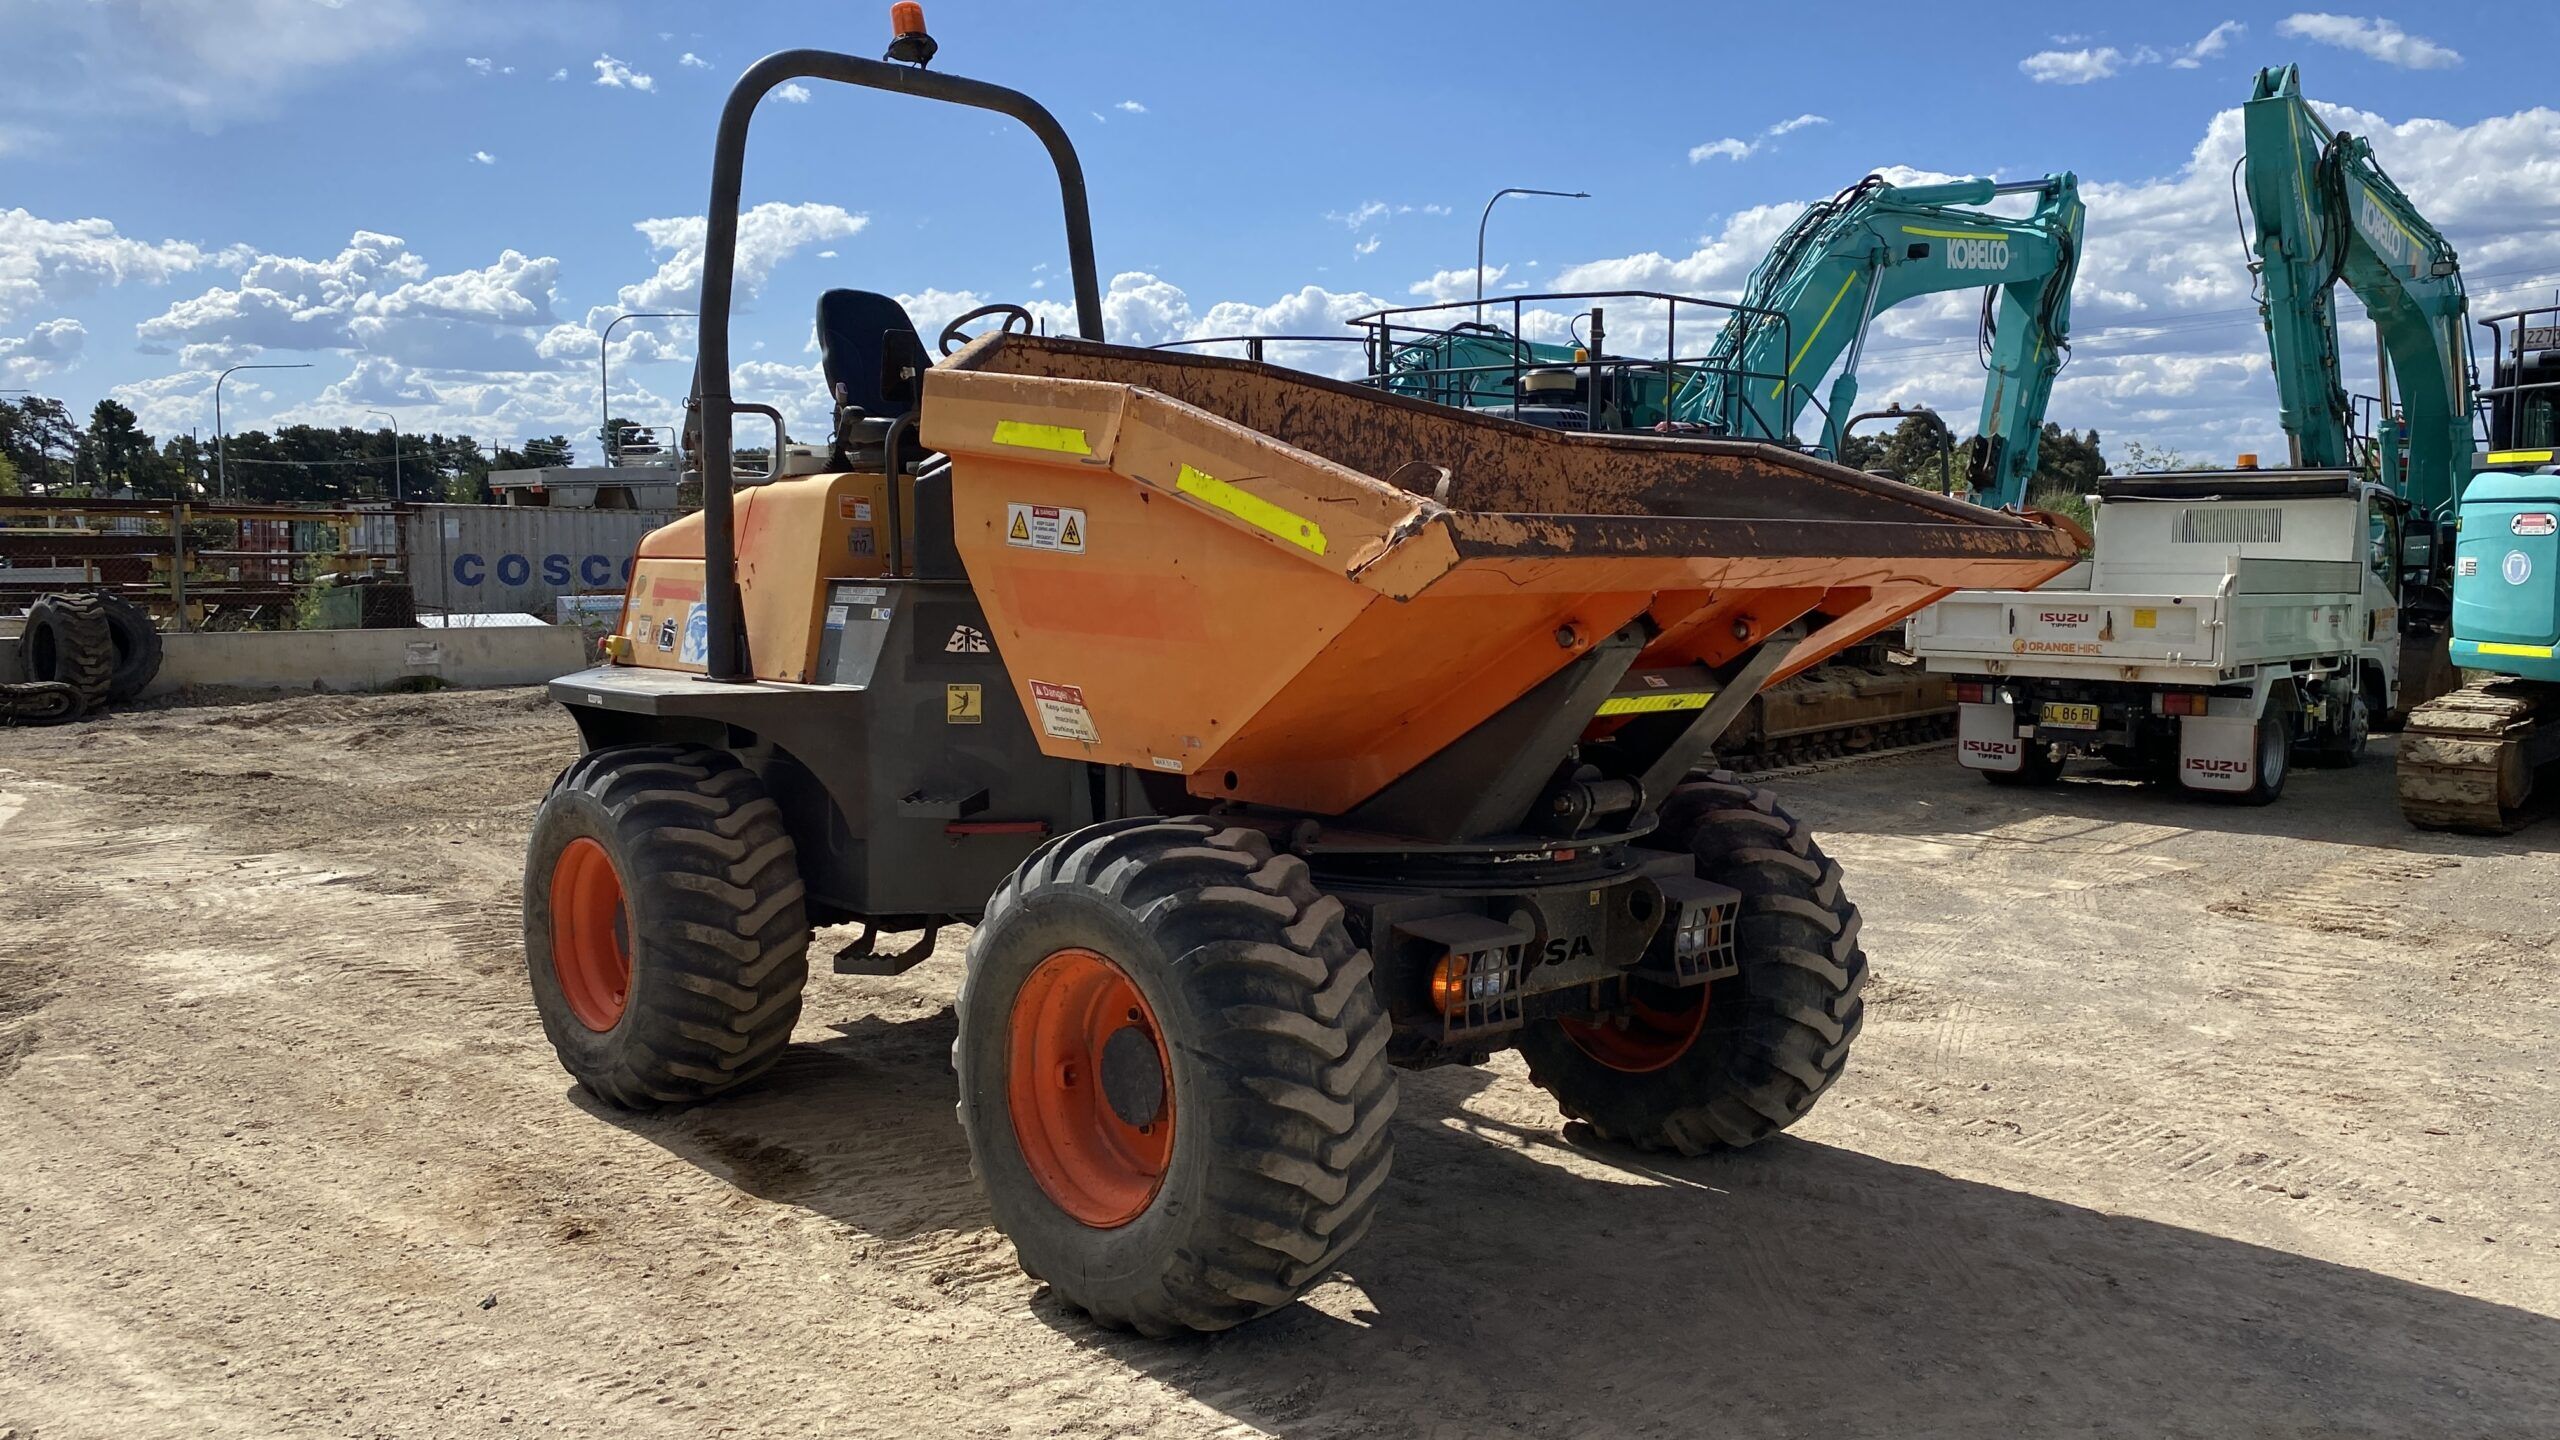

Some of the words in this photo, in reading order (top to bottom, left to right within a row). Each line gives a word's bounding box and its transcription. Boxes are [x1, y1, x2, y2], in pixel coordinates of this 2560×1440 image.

[2362, 194, 2400, 259] KOBELCO
[1946, 238, 2009, 270] KOBELCO
[2040, 612, 2089, 623] ISUZU
[2028, 641, 2076, 653] ORANGE
[2043, 704, 2056, 719] DL
[2062, 707, 2078, 721] 86
[1052, 726, 1075, 735] working
[1963, 740, 2016, 755] ISUZU
[1977, 752, 2003, 760] TIPPER
[2186, 758, 2247, 773] ISUZU
[2202, 771, 2231, 779] TIPPER
